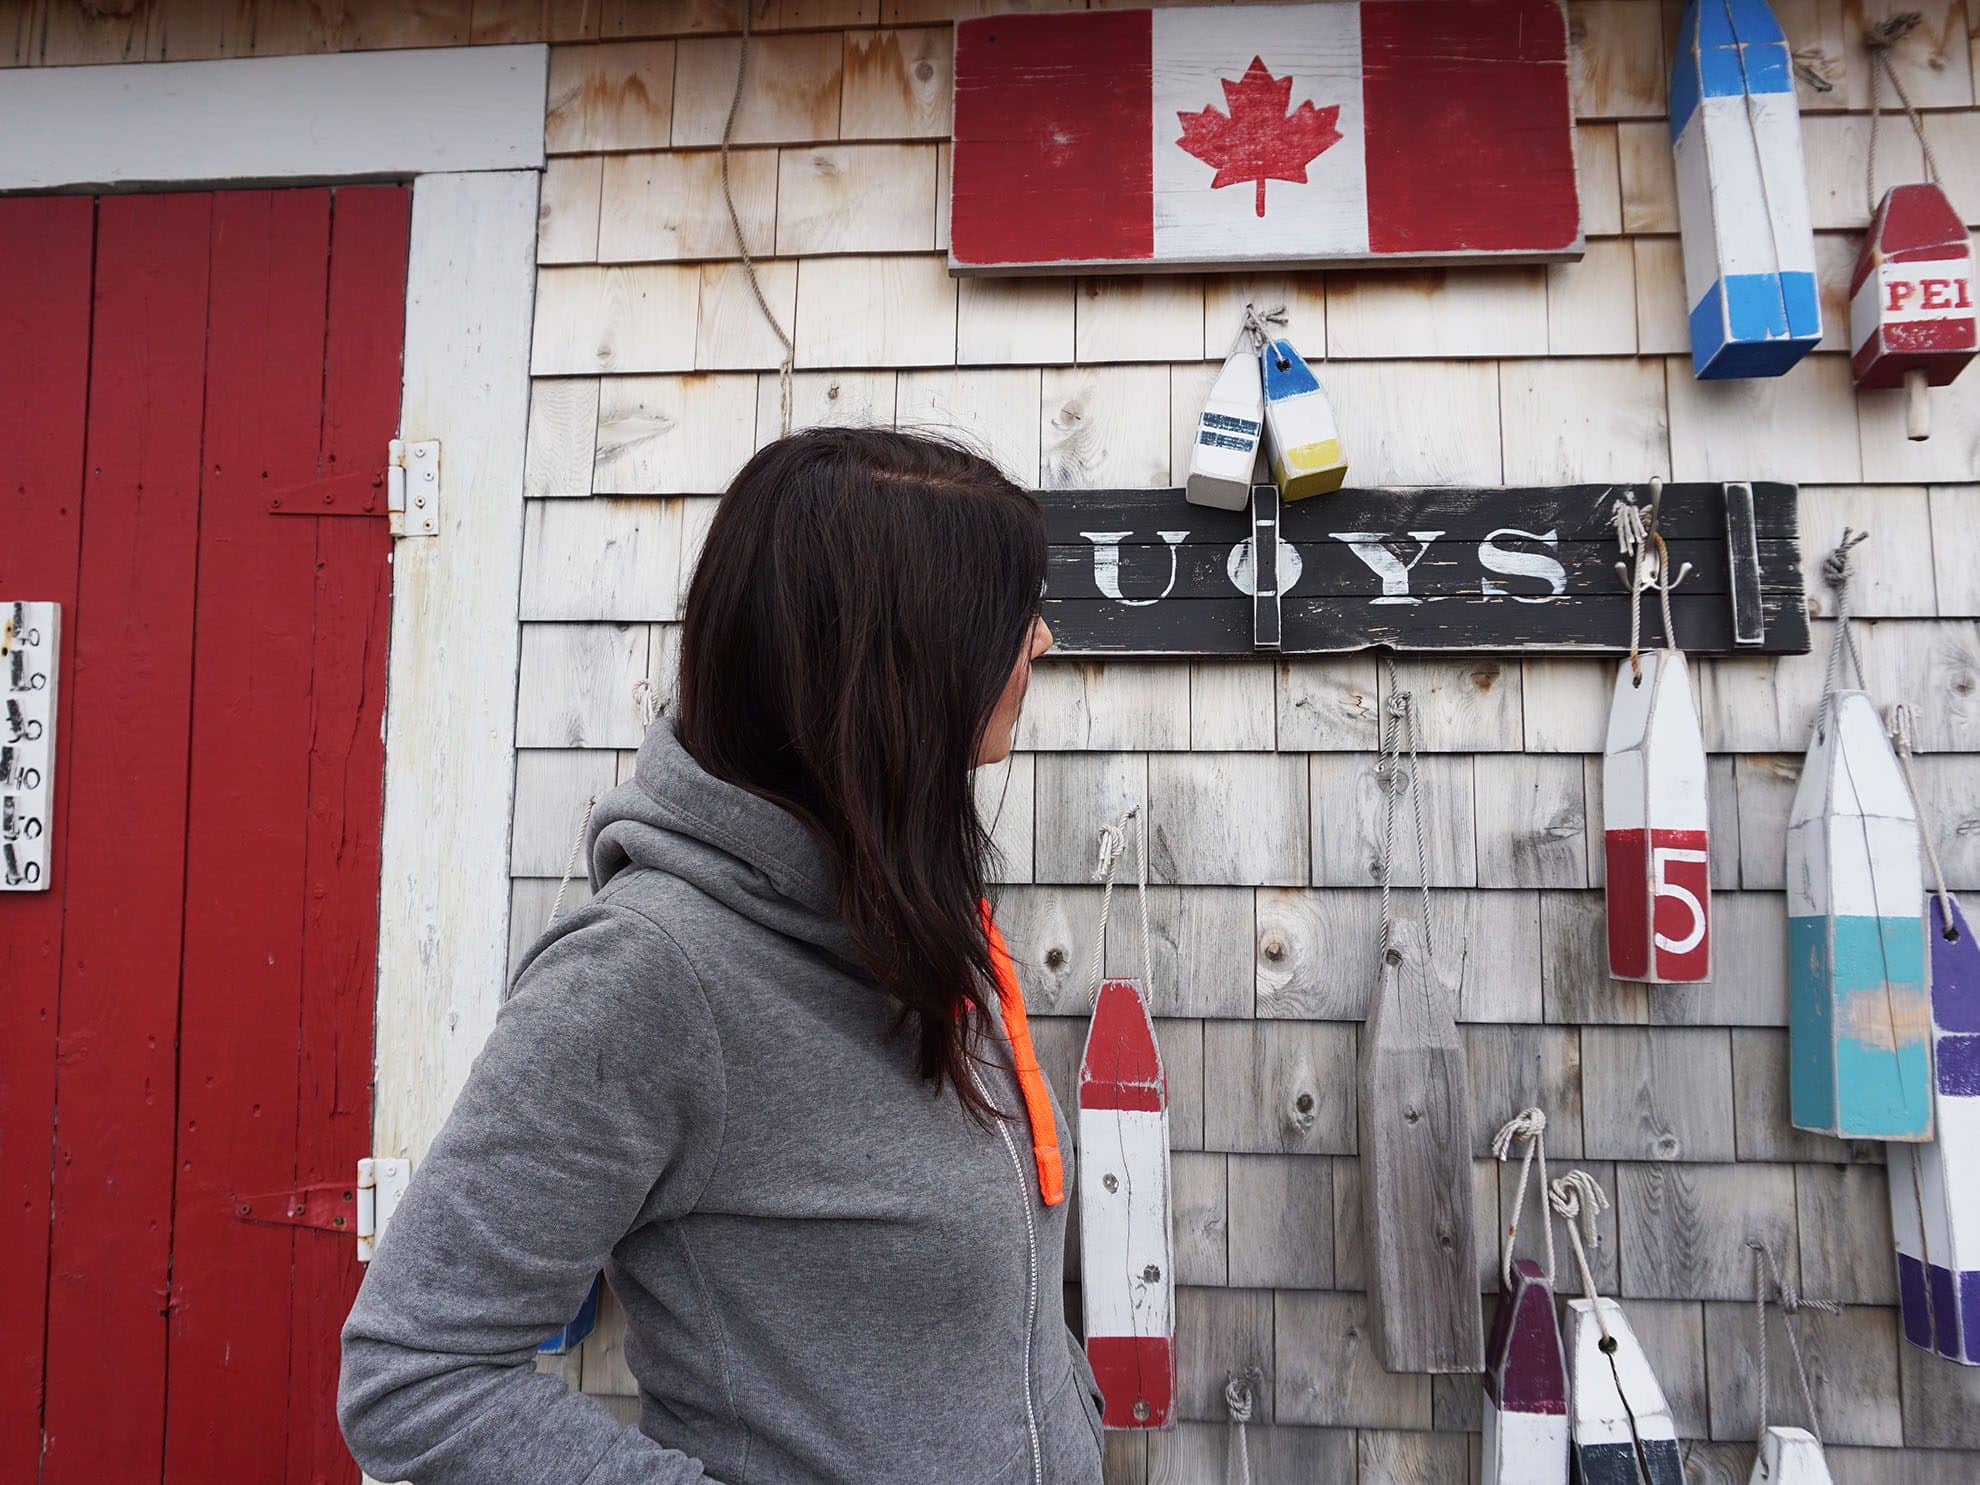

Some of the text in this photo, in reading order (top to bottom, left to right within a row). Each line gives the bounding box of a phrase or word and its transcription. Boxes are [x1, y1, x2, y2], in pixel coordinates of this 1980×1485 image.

[1885, 278, 1974, 312] PEI
[1037, 527, 1573, 606] UOYS
[1653, 847, 1707, 955] 5
